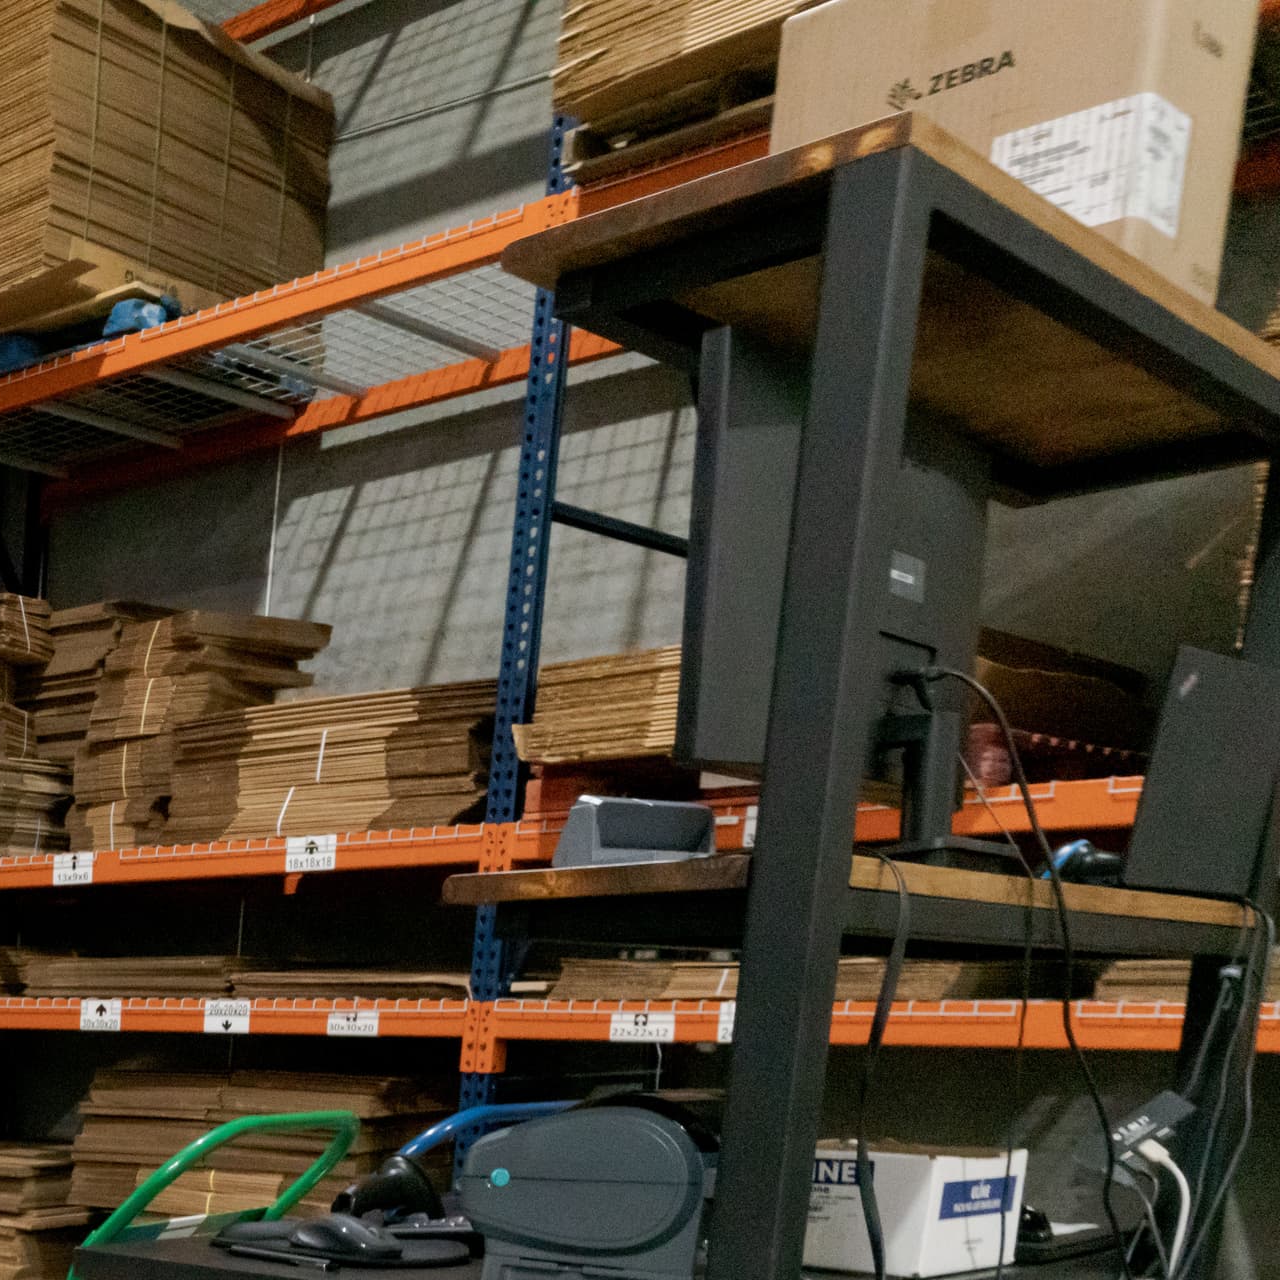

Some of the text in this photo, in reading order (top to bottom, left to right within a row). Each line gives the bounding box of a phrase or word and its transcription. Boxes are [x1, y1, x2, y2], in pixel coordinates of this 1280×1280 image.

[928, 50, 1016, 96] ZEBRA
[288, 857, 332, 869] 18x18x18
[82, 1018, 118, 1029] 30x30x20
[329, 1023, 374, 1033] 30x30x20
[611, 1028, 669, 1038] 22x22x12
